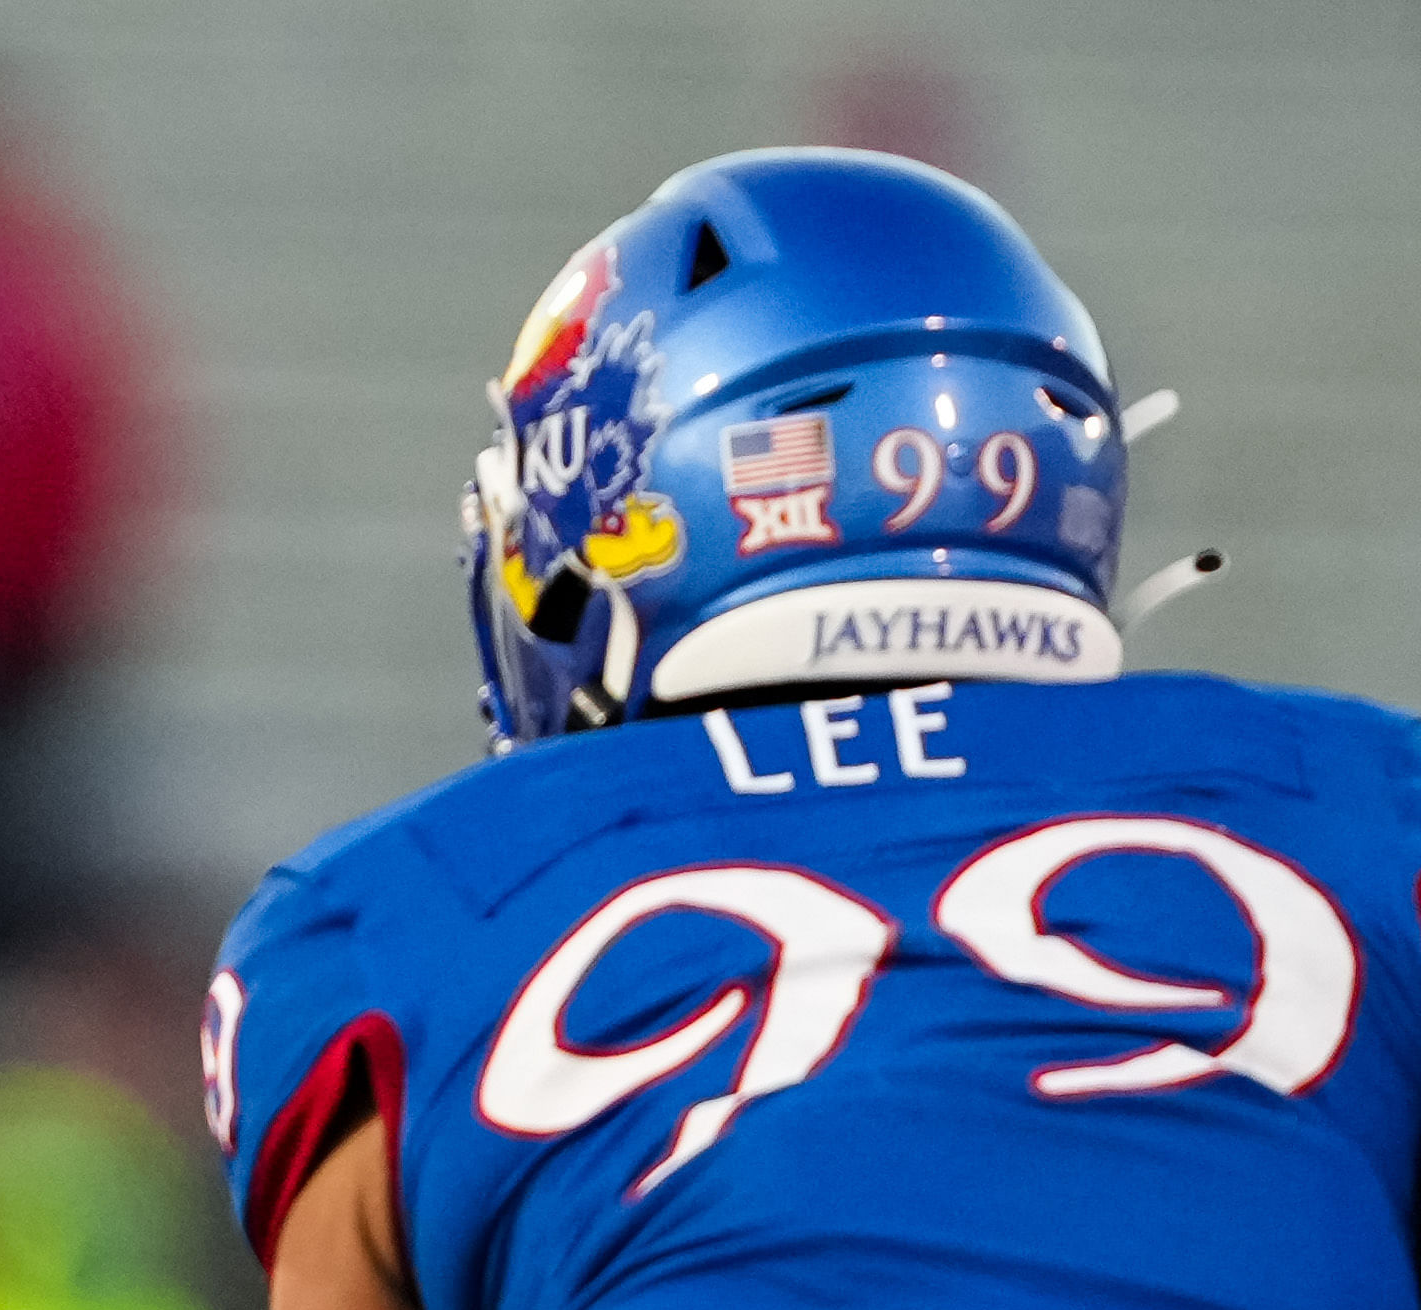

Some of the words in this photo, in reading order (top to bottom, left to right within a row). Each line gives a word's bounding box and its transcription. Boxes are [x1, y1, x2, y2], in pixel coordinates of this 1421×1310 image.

[809, 608, 1083, 665] JAYHAWKS
[702, 682, 969, 794] LEE
[477, 811, 1366, 1200] 99
